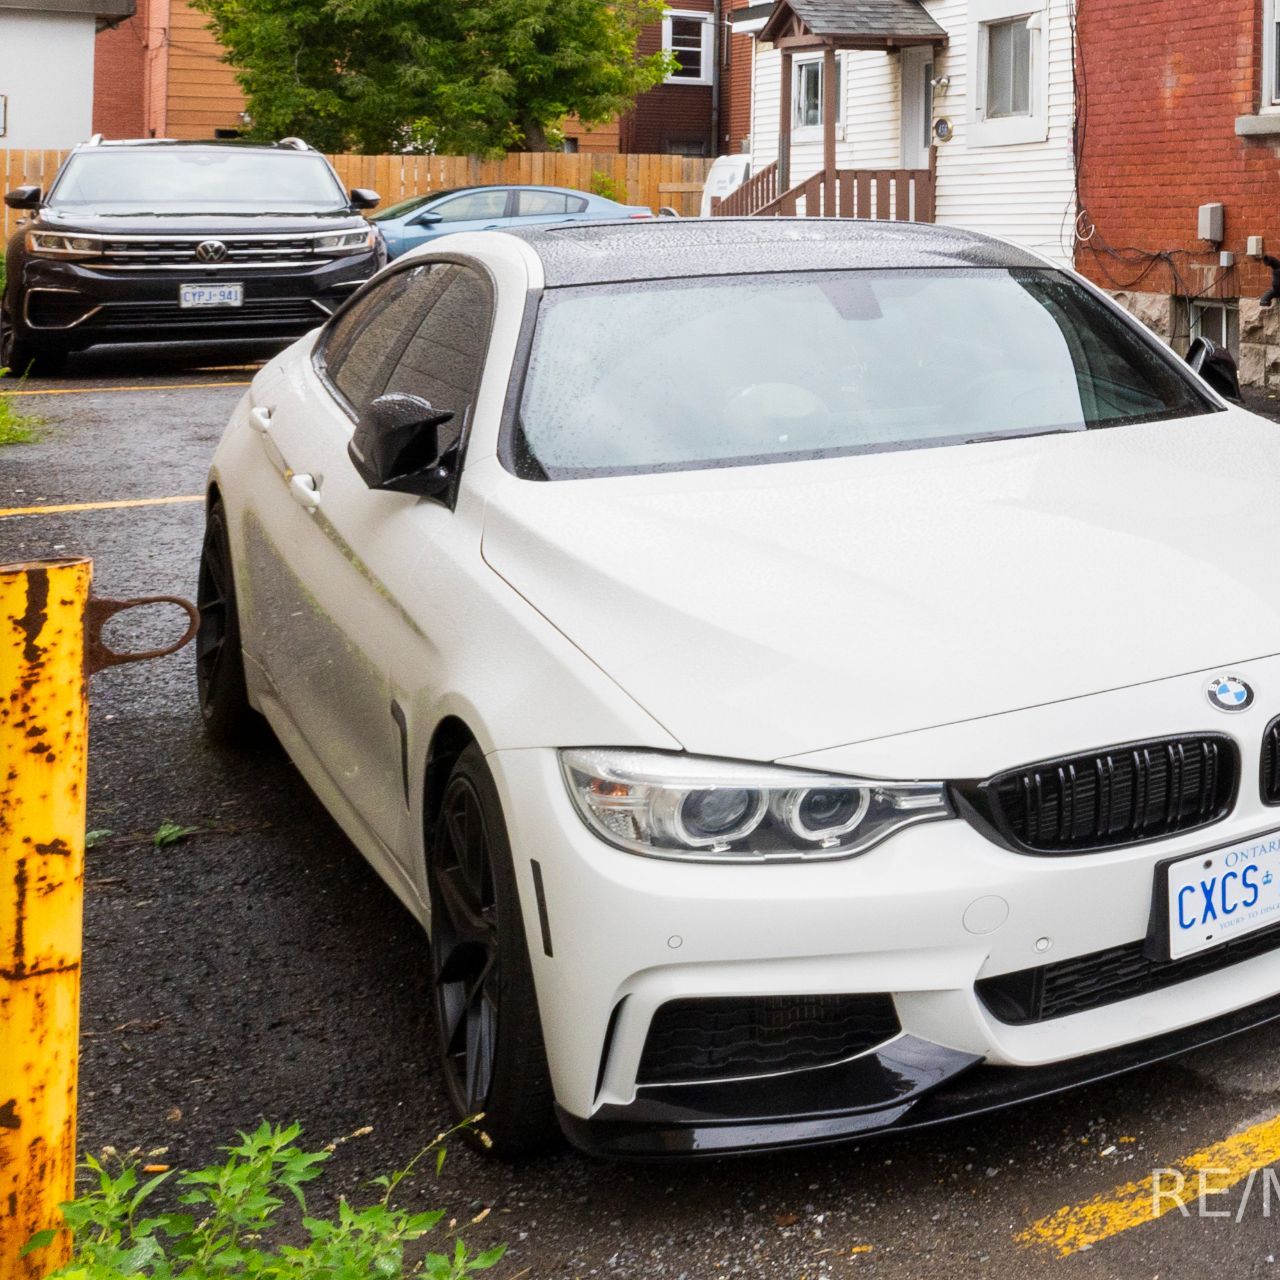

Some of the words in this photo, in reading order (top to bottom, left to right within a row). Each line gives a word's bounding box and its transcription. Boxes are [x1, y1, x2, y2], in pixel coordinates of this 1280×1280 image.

[1178, 864, 1259, 930] CXCS
[1219, 915, 1246, 930] YOURS
[1248, 910, 1259, 920] TO
